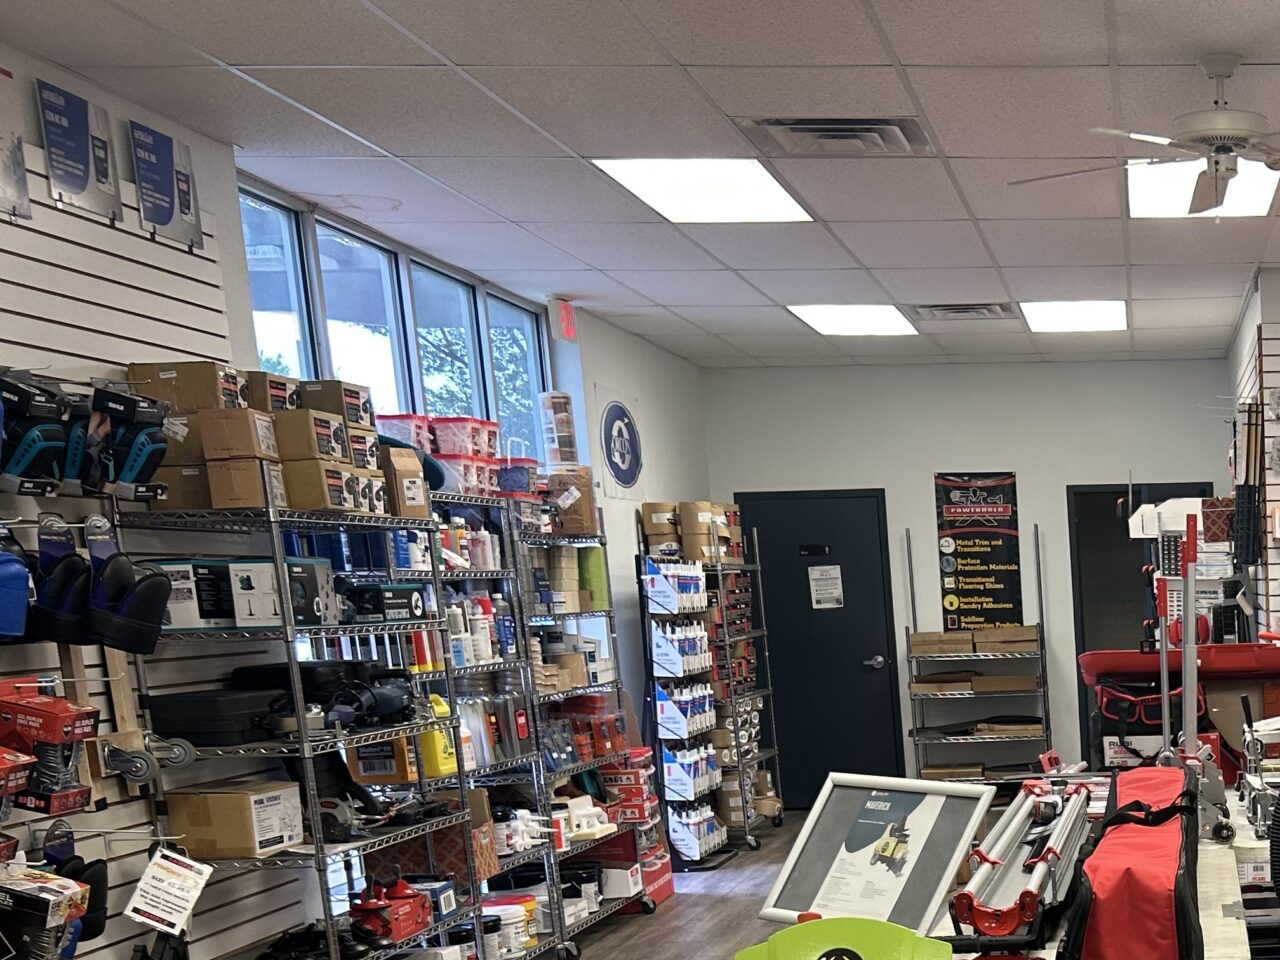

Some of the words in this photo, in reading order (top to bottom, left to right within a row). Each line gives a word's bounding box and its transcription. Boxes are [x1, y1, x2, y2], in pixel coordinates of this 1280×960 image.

[958, 582, 984, 590] Flooring
[960, 602, 981, 610] Sundry
[865, 800, 892, 811] MAVERICK
